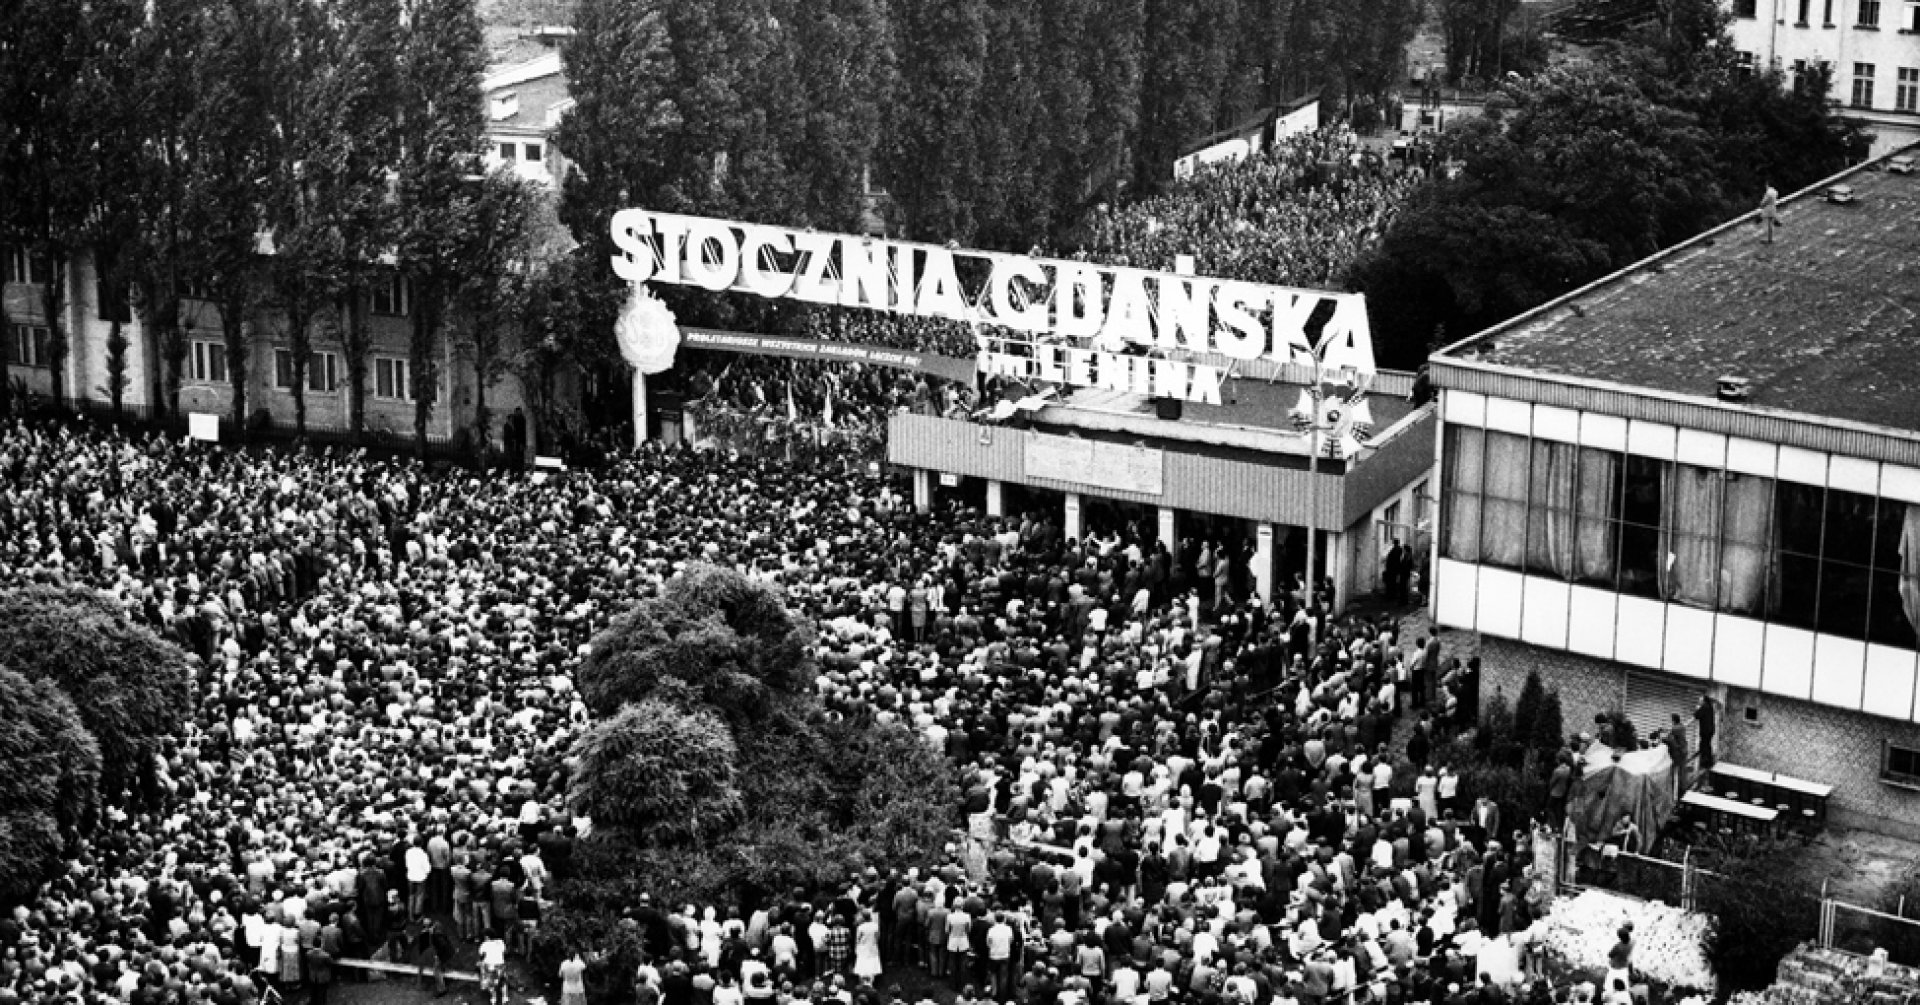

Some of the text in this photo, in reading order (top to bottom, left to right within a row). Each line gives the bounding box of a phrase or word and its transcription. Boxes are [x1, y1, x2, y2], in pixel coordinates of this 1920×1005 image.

[610, 207, 1376, 374] STOCZNIA GDAŃSKA
[1040, 344, 1222, 405] LENINA
